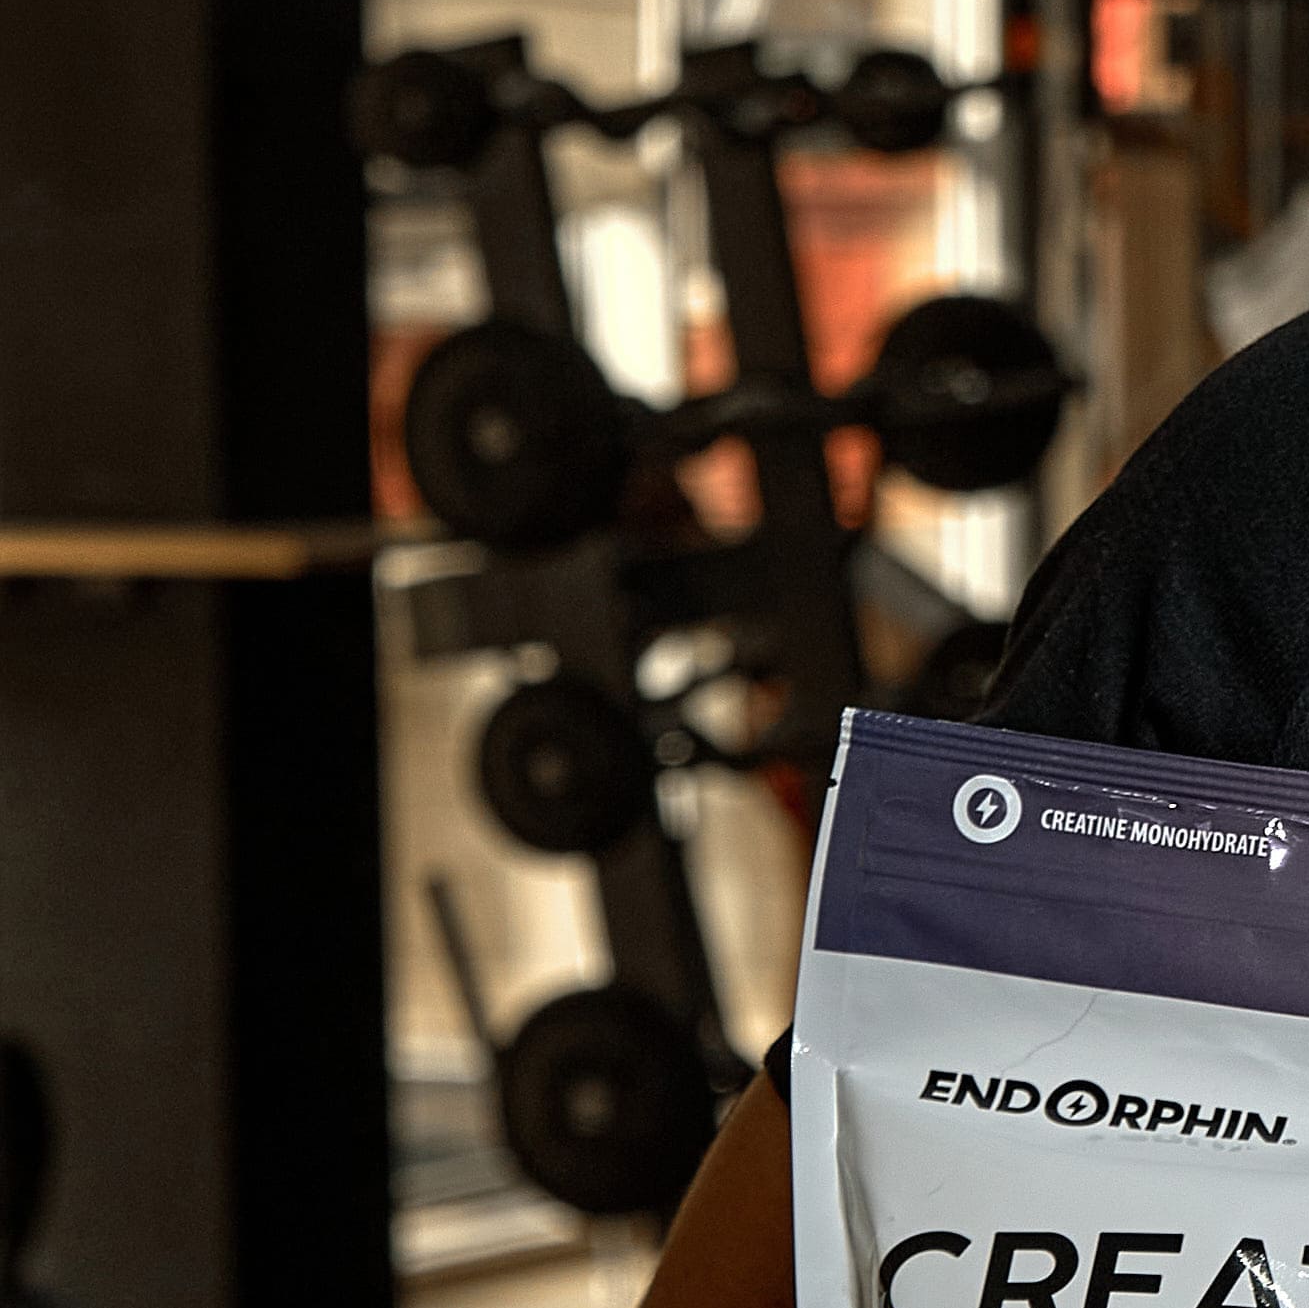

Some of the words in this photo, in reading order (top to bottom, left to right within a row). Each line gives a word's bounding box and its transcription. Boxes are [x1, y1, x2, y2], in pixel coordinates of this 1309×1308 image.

[1040, 808, 1128, 840] CREATINE
[1130, 821, 1270, 857] MONOHYDRATE
[920, 1069, 1291, 1147] ENDORPHIN
